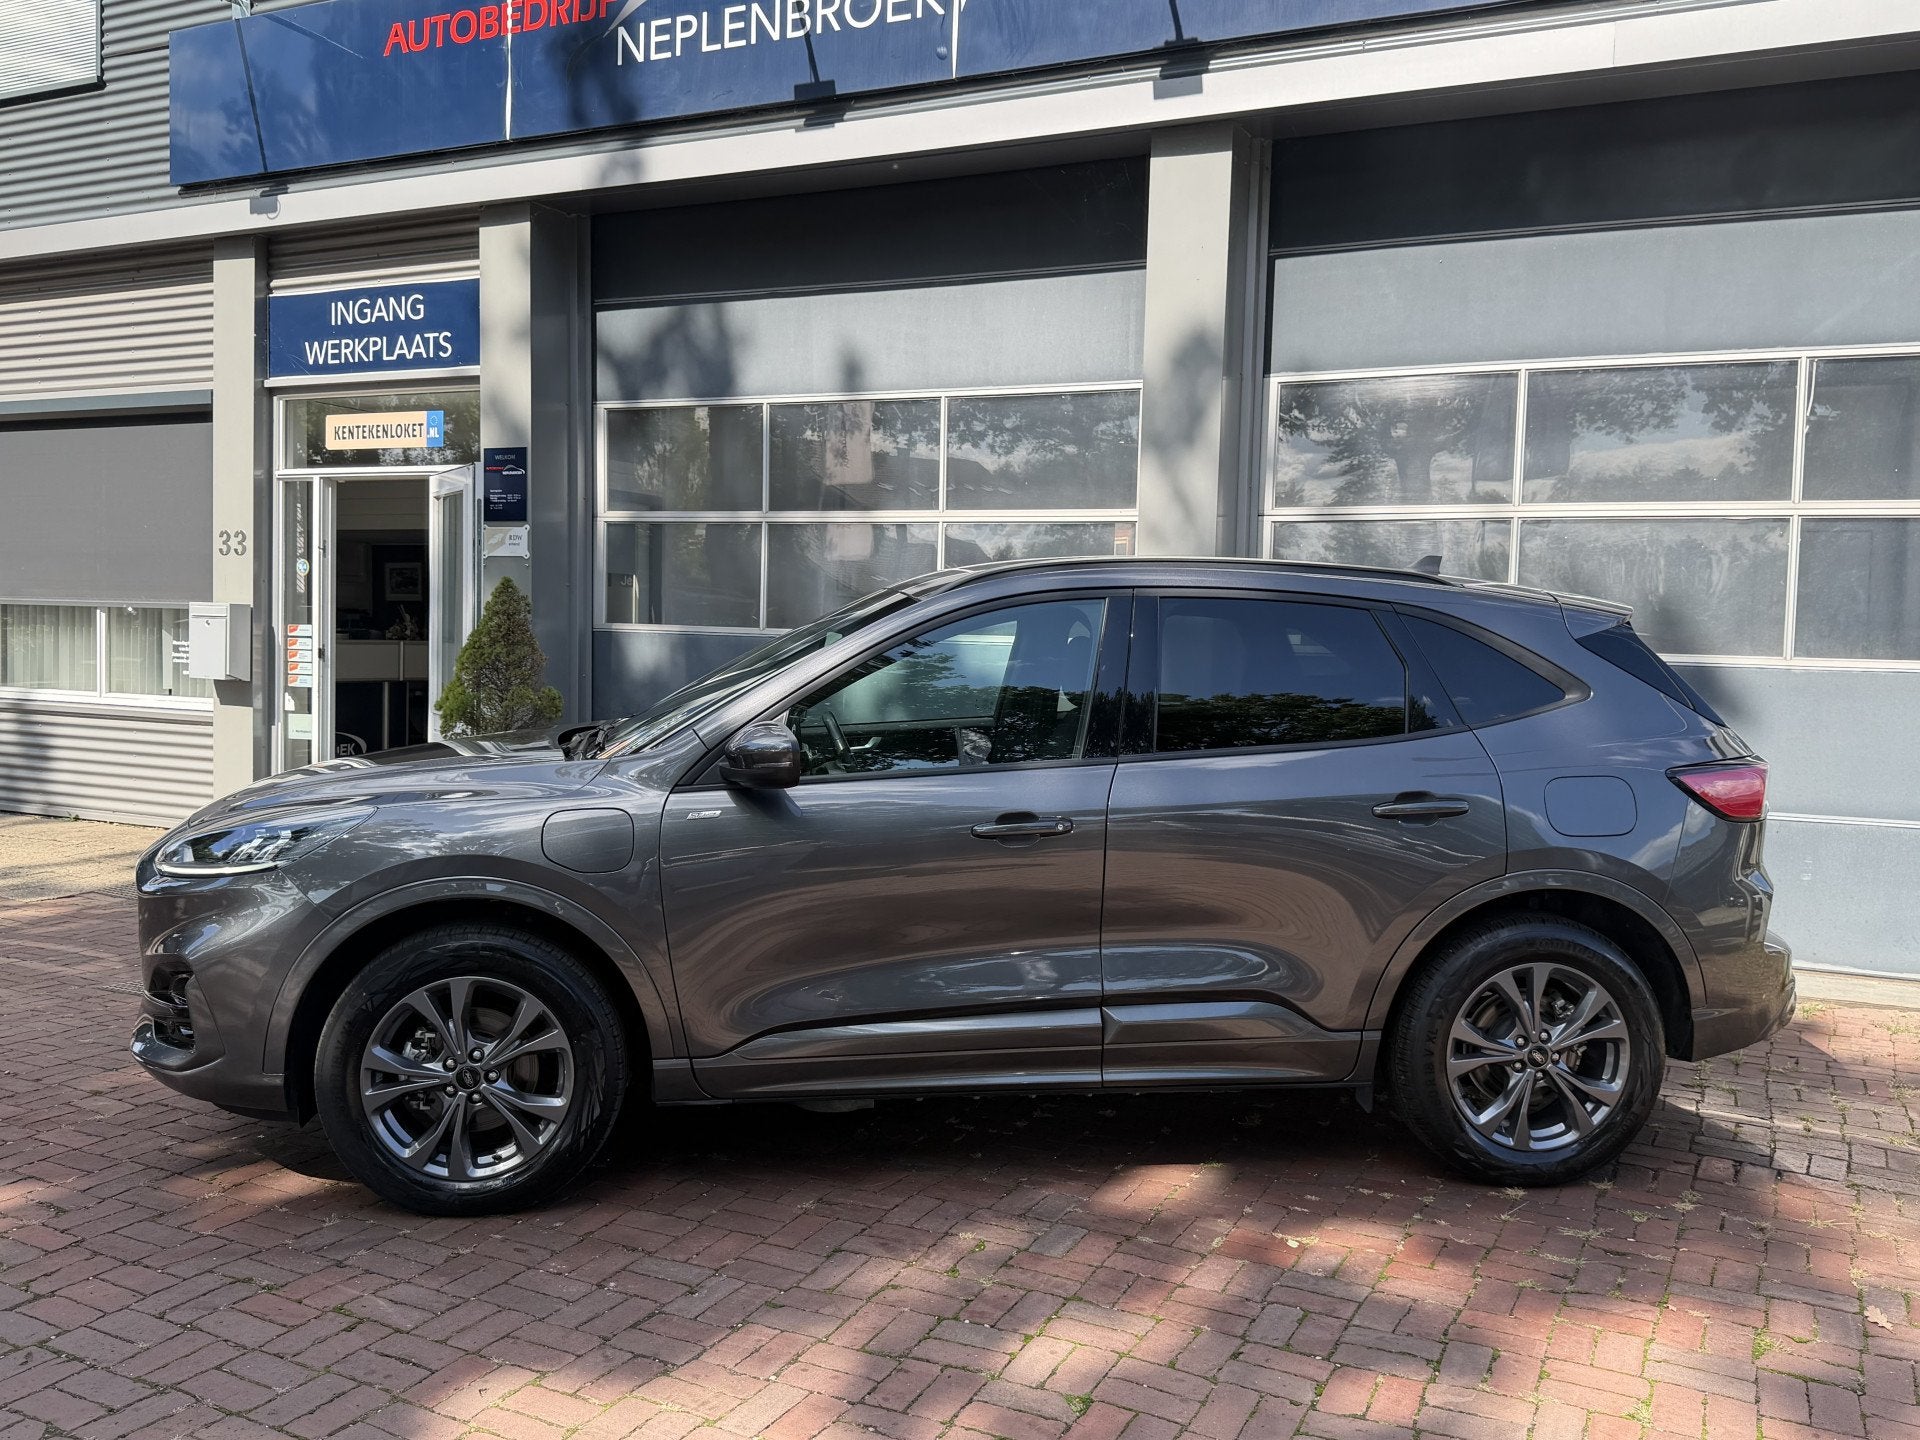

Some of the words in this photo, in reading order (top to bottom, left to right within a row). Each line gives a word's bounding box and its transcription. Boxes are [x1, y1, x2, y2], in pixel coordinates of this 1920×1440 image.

[331, 294, 425, 326] INGANG
[304, 331, 453, 366] WERKPLAATS
[334, 423, 424, 441] KENTEKENLOKET
[218, 529, 247, 556] 33
[336, 743, 356, 756] EK
